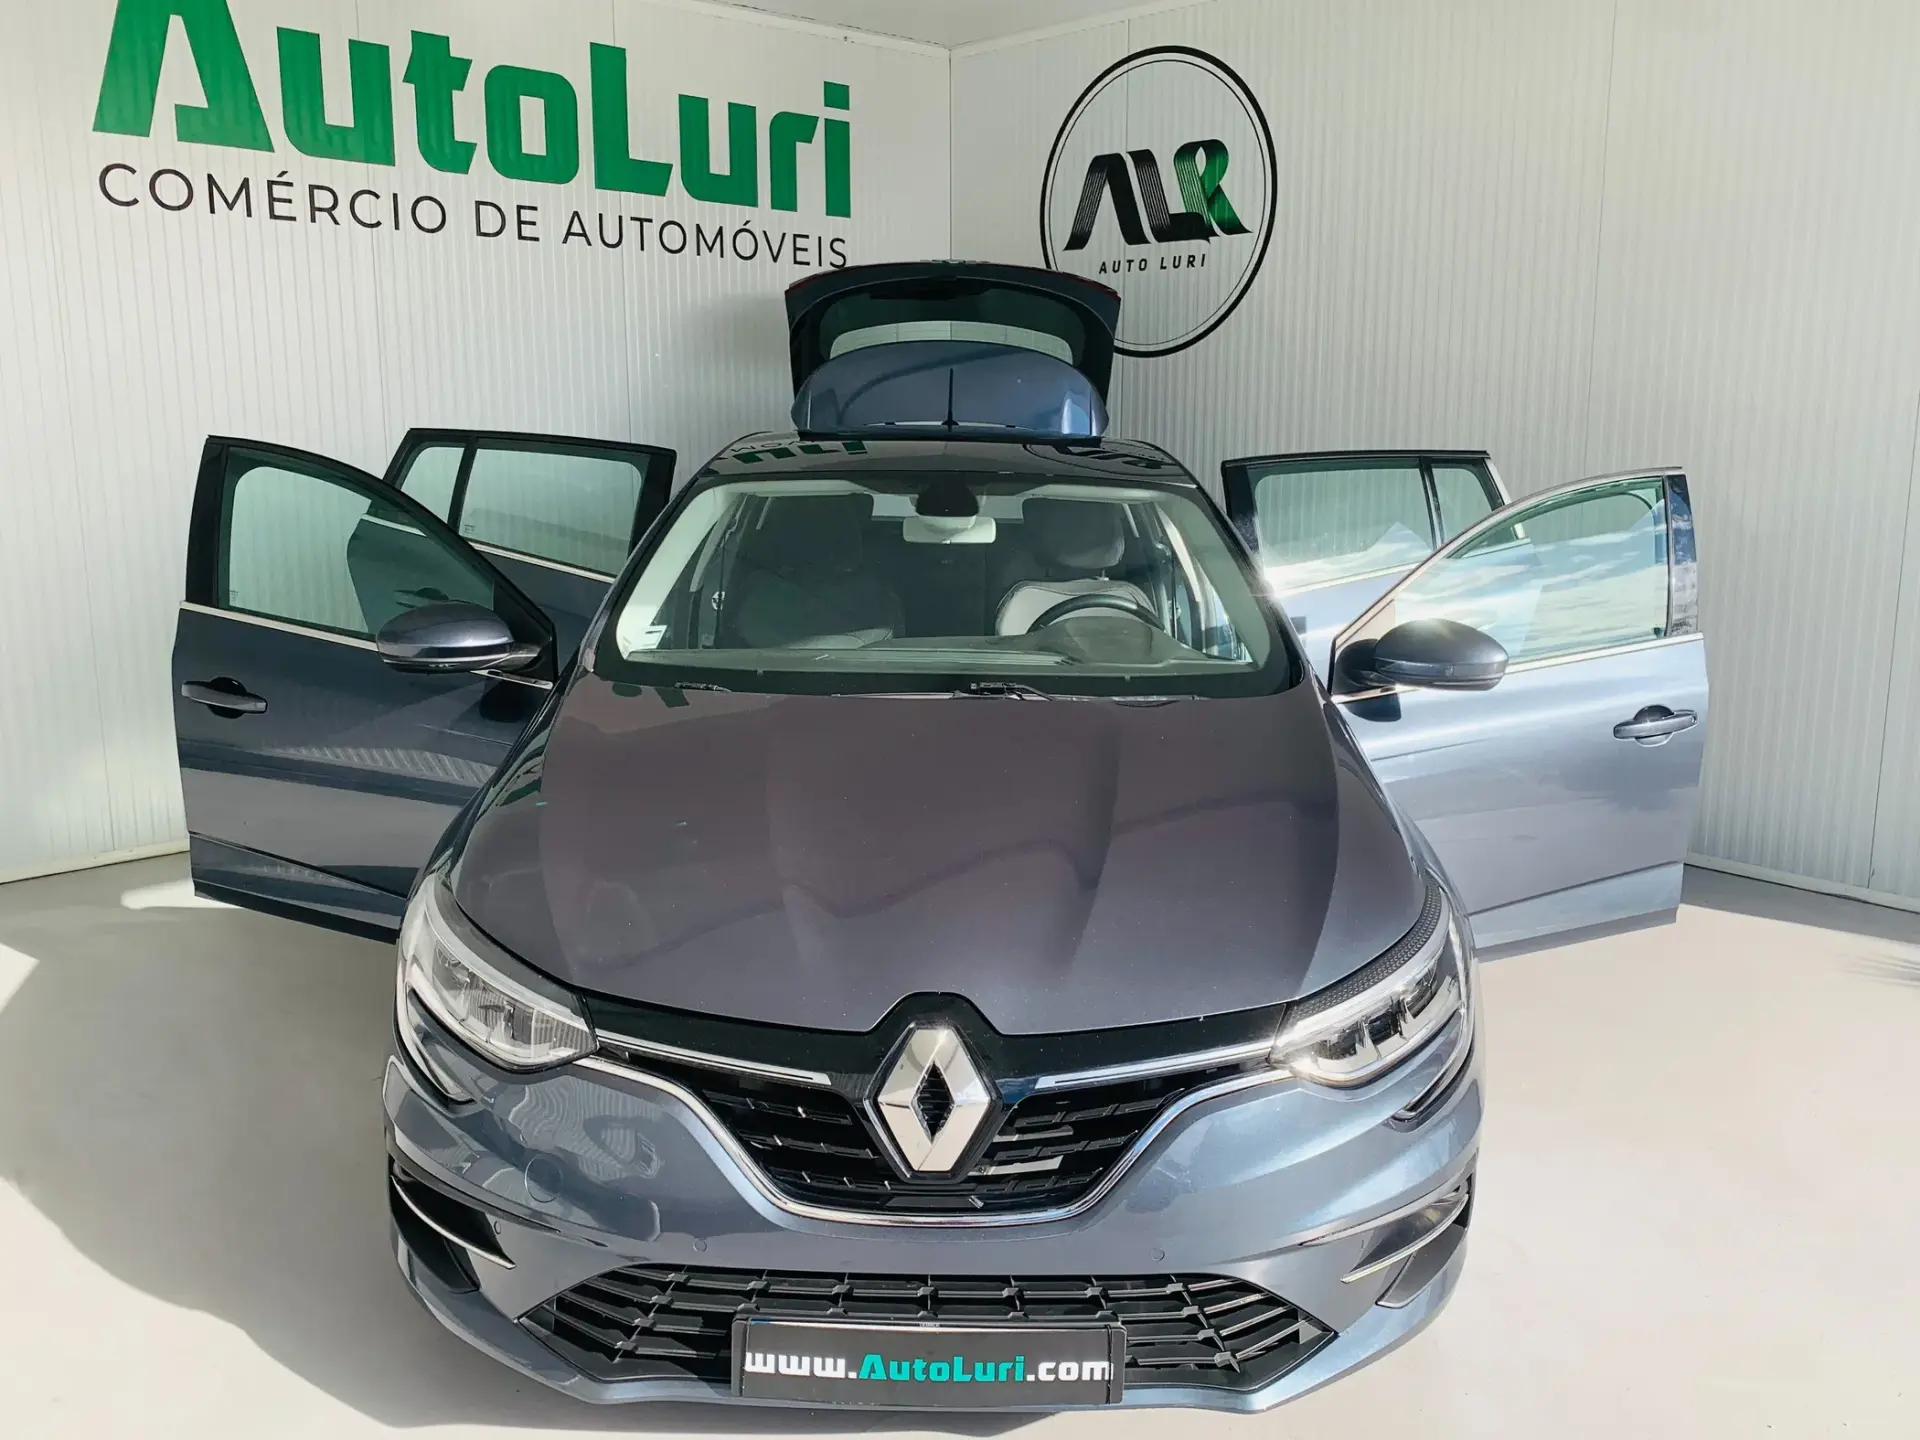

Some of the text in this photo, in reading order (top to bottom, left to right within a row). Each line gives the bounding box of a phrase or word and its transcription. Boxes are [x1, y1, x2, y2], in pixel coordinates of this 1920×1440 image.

[92, 0, 851, 218] AutoLuri
[99, 162, 848, 269] COMÉRCIO DE AUTOMÓVEIS
[1098, 254, 1206, 274] AUTO LURI
[744, 1351, 1113, 1382] www.AutoLuri.com
